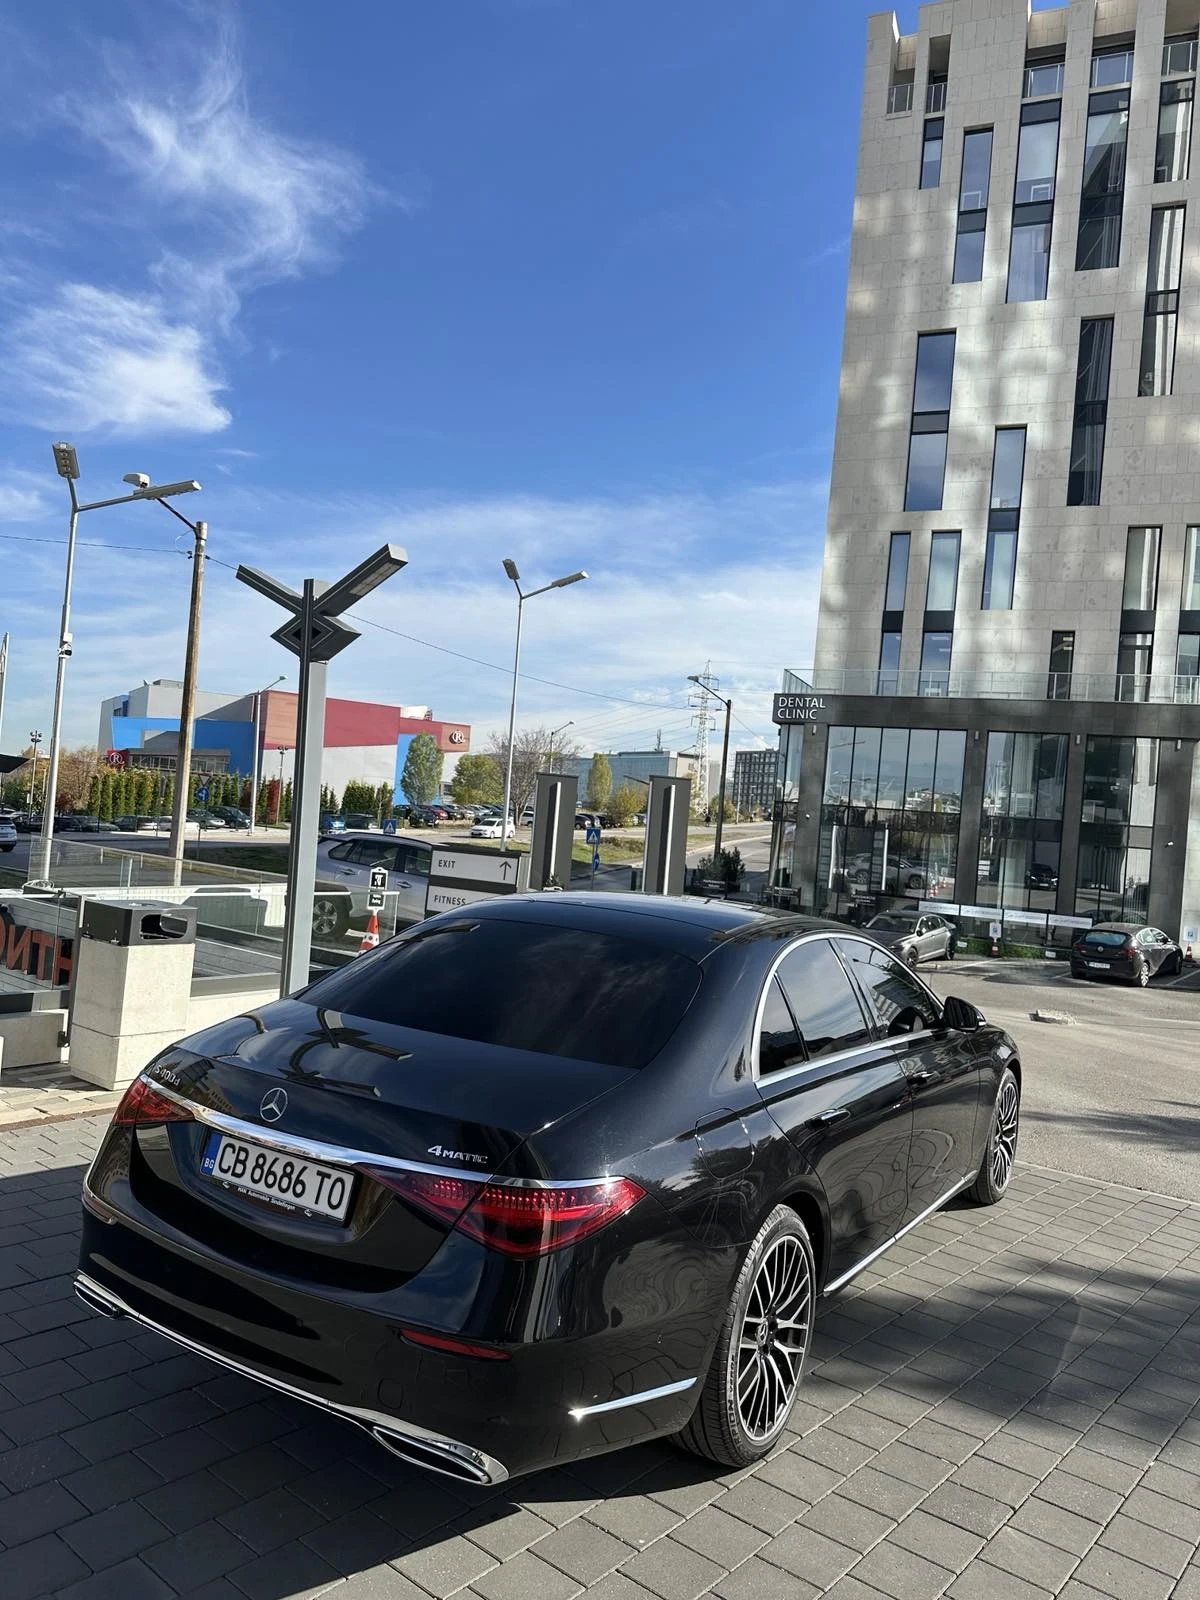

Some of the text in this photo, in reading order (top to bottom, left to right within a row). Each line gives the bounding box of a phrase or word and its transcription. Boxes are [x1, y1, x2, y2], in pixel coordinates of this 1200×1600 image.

[778, 697, 826, 708] DENTAL
[777, 708, 818, 720] CLINIC
[438, 859, 456, 868] EXIT
[434, 894, 466, 906] FITNESS
[427, 1145, 488, 1164] 4MATIC
[204, 1158, 215, 1169] BG
[218, 1143, 345, 1210] CB 8686 TO
